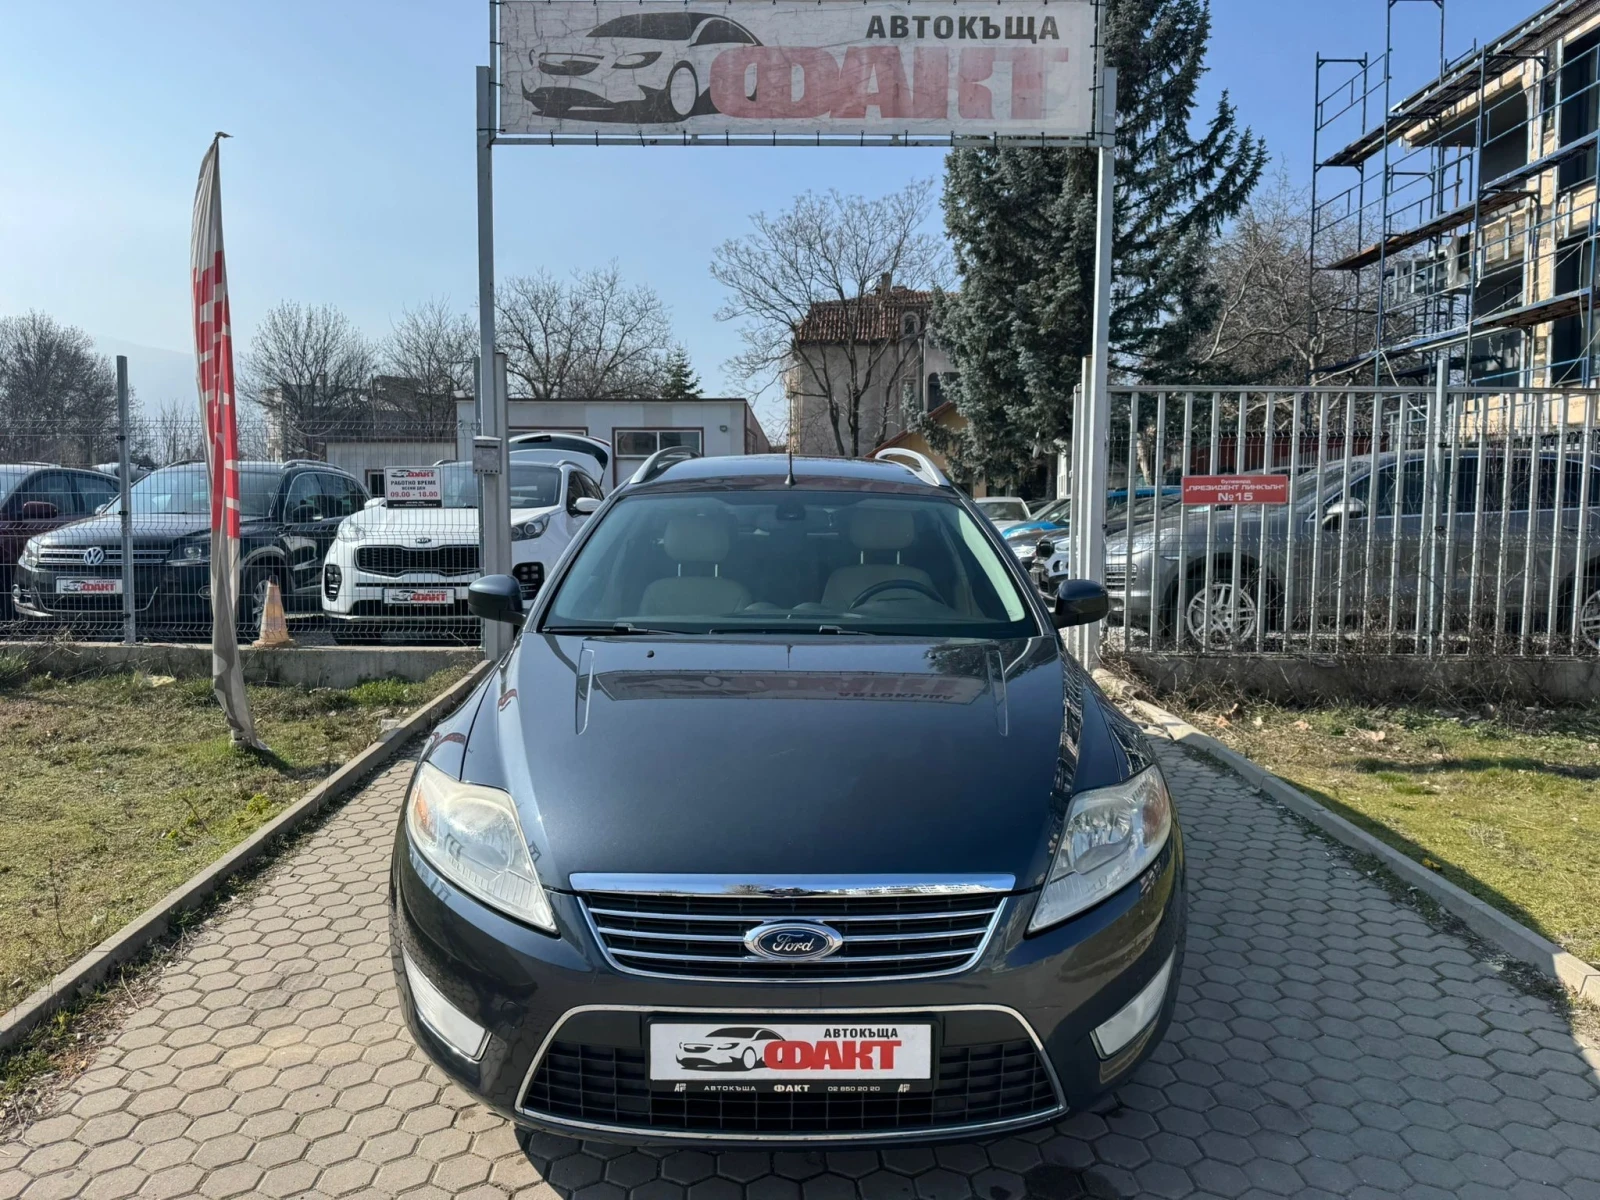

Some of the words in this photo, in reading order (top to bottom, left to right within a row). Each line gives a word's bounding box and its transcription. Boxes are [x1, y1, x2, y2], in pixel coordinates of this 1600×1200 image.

[865, 15, 1060, 44] АВТОКЪЩА
[709, 46, 1069, 119] ФАКТ
[772, 933, 815, 951] Ford
[823, 1027, 898, 1040] АВТОКЪЩА
[763, 1040, 902, 1070] ФАКТ
[773, 1084, 810, 1092] ФАКТ
